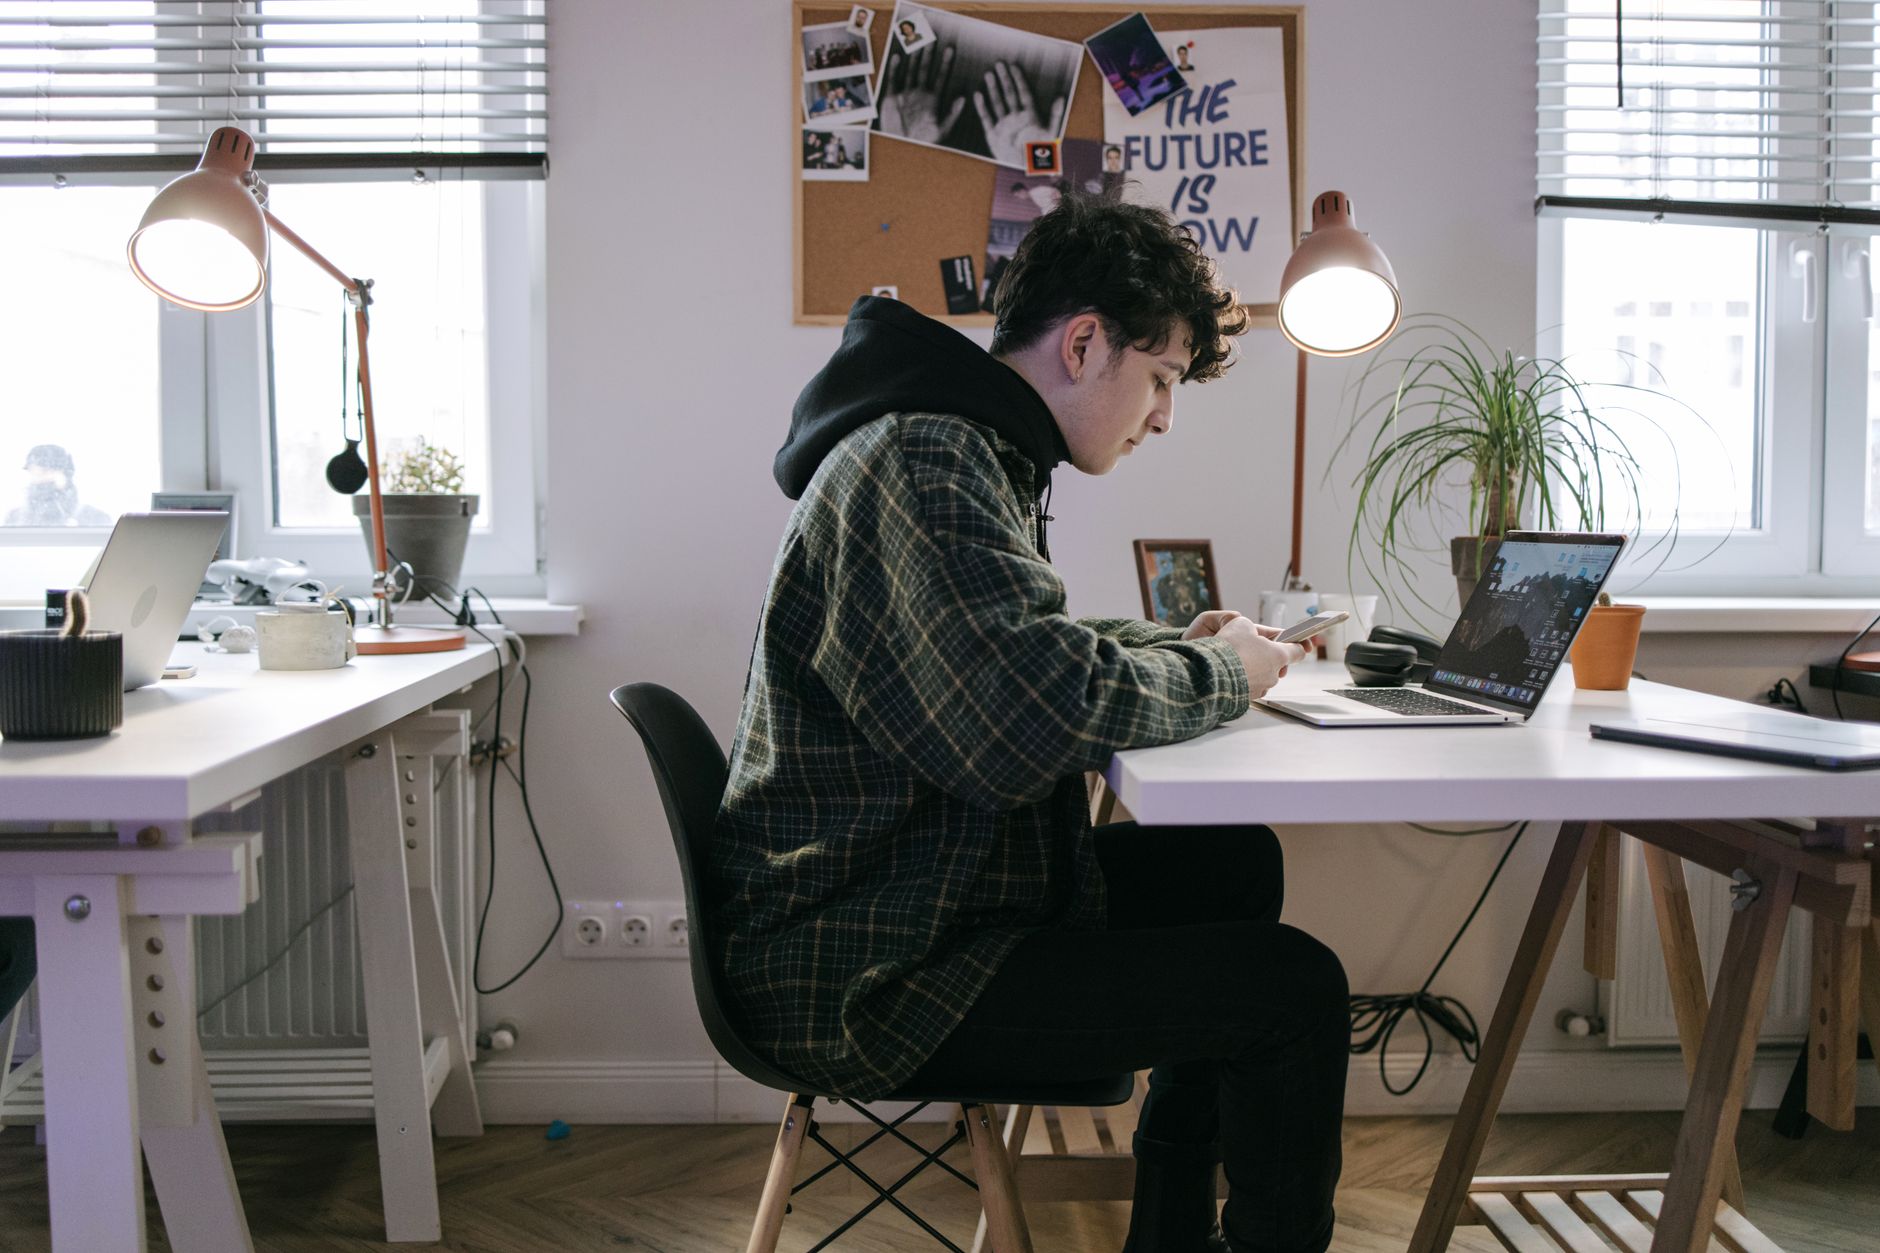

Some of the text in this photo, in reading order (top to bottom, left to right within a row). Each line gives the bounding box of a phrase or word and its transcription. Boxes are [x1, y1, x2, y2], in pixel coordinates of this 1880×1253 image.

[1165, 79, 1237, 128] THE
[1124, 129, 1269, 171] FUTURE
[1171, 174, 1217, 214] IS
[1177, 216, 1259, 252] OW
